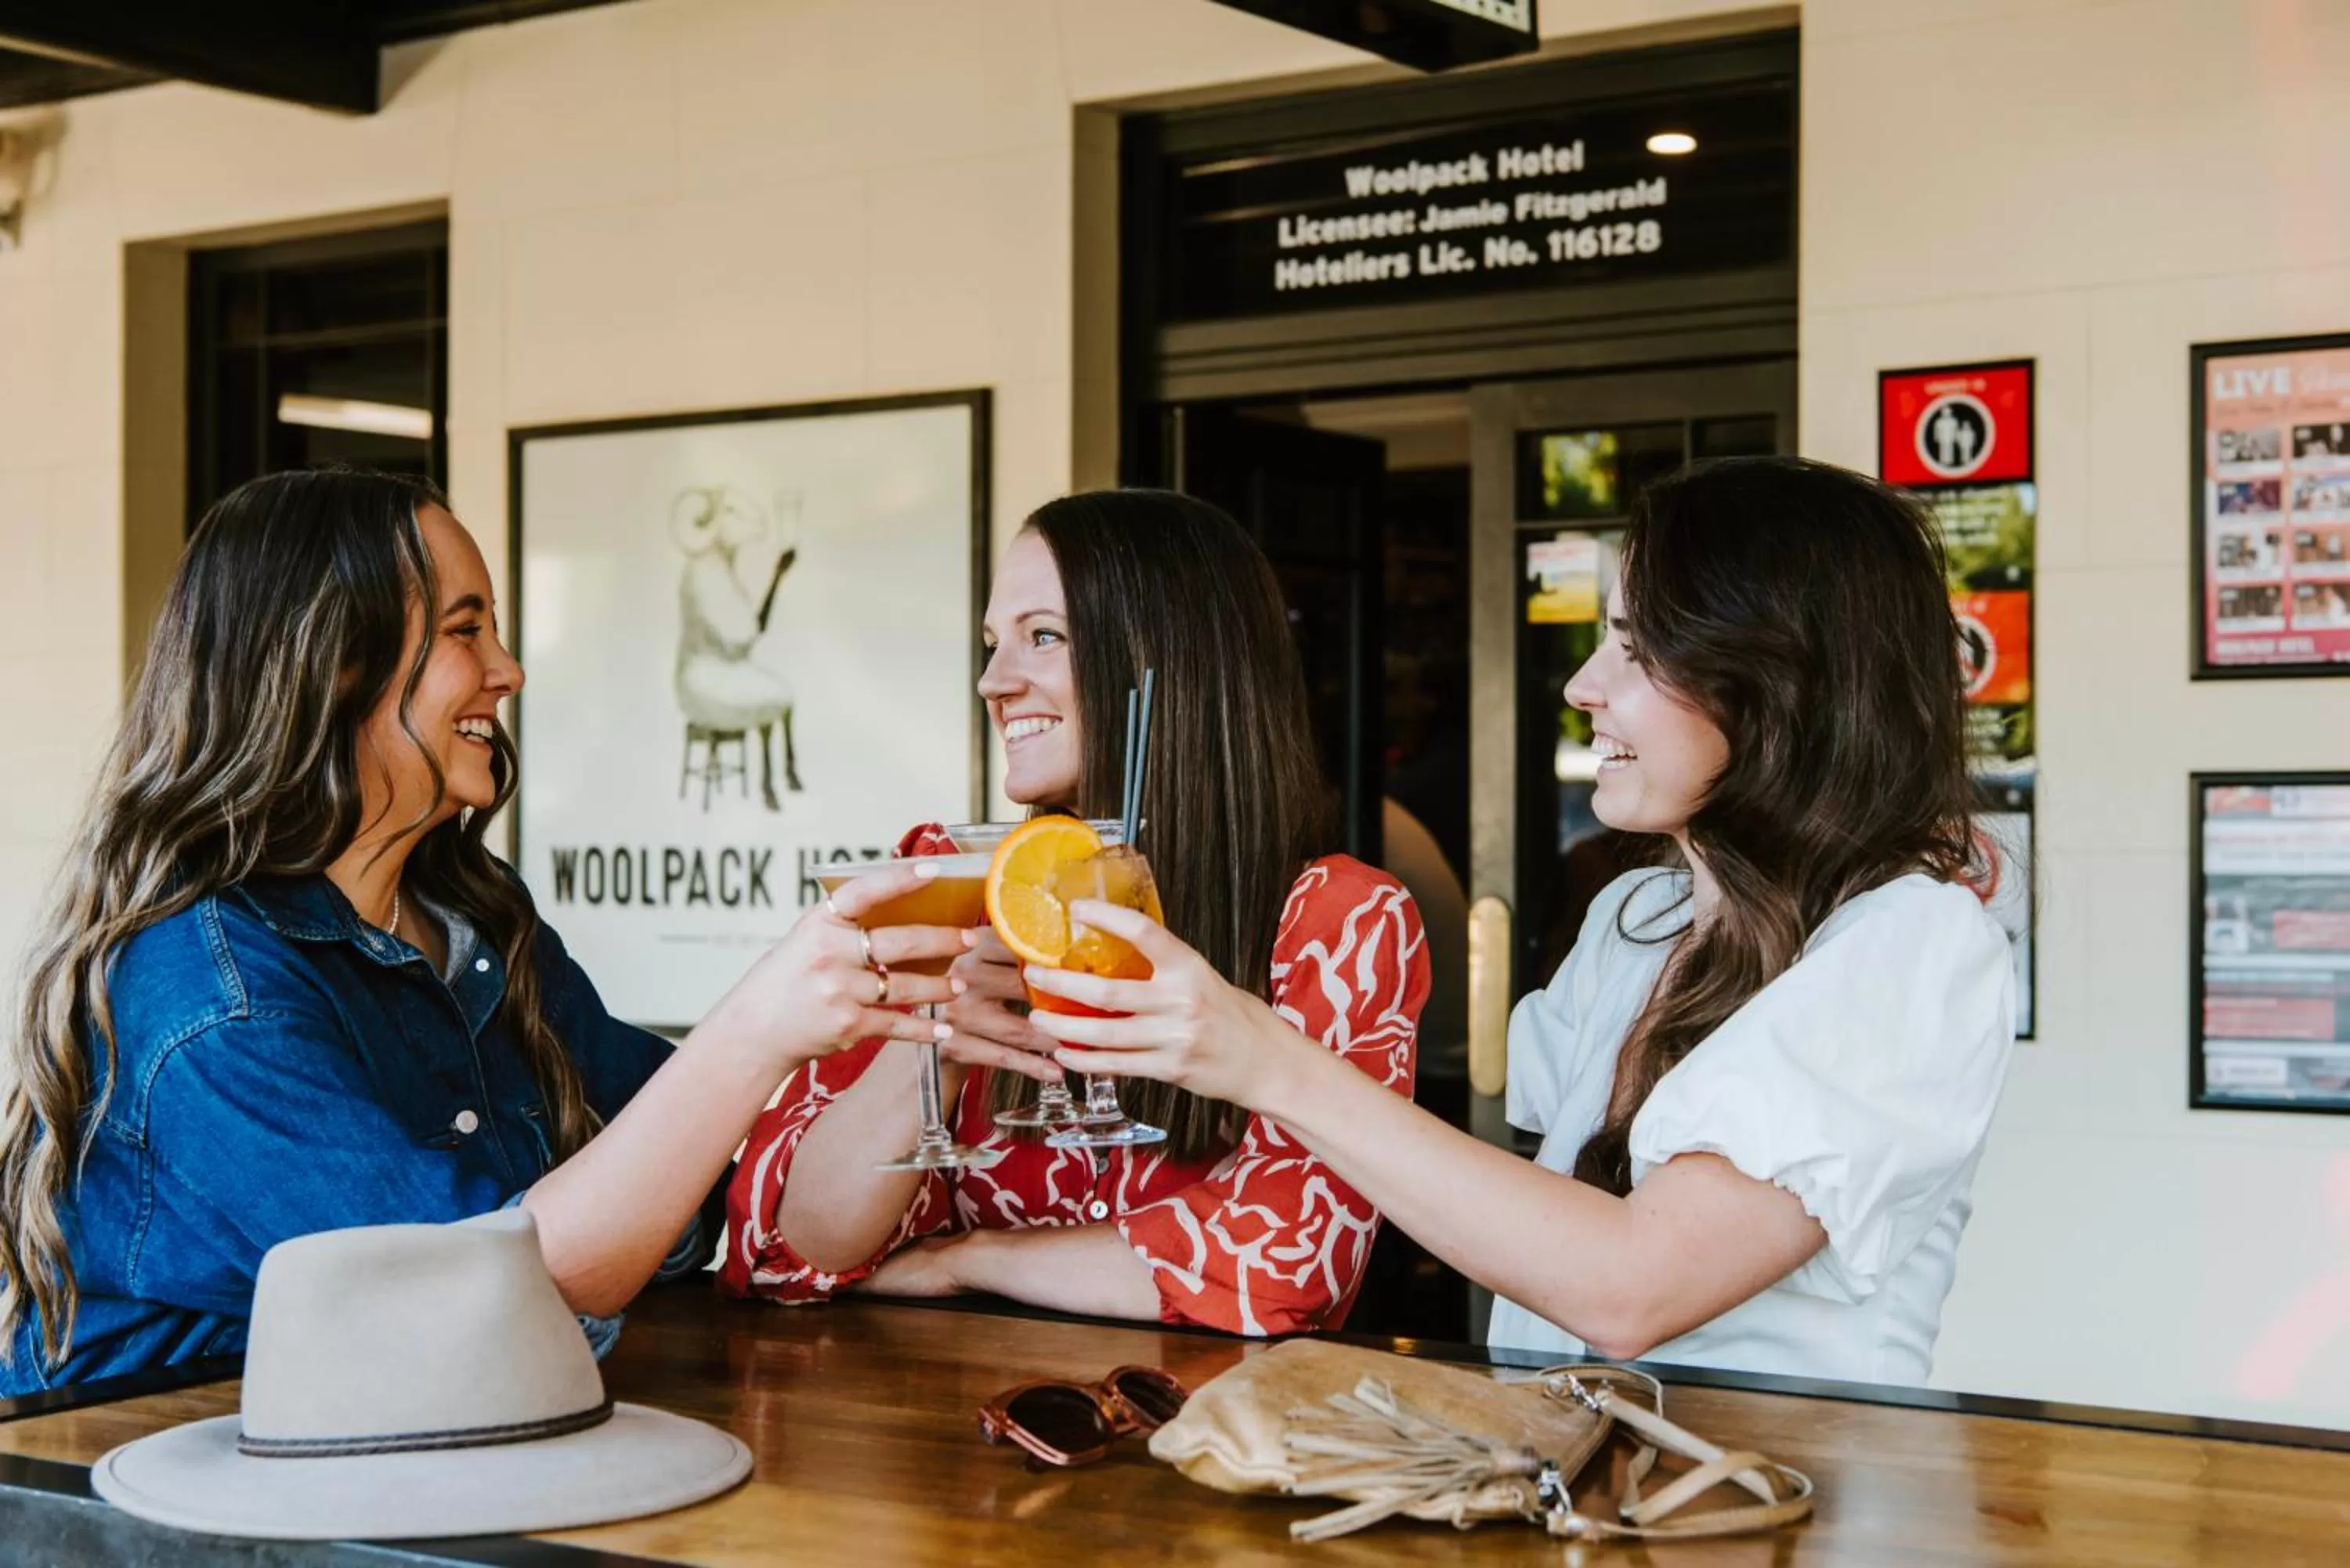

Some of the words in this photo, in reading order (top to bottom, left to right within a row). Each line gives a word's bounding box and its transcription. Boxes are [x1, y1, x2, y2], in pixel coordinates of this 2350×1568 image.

[1346, 154, 1488, 197] Woolpack
[1498, 141, 1583, 179] Hotel
[1278, 210, 1415, 247] Licensee:
[1419, 200, 1508, 232] Jamie
[1516, 178, 1666, 221] Fitzgerald
[1276, 251, 1410, 289] Hoteliers
[1419, 241, 1475, 274] Lic.
[1485, 237, 1538, 267] No.
[1548, 220, 1661, 261] 116128
[551, 847, 772, 907] WOOLPACK
